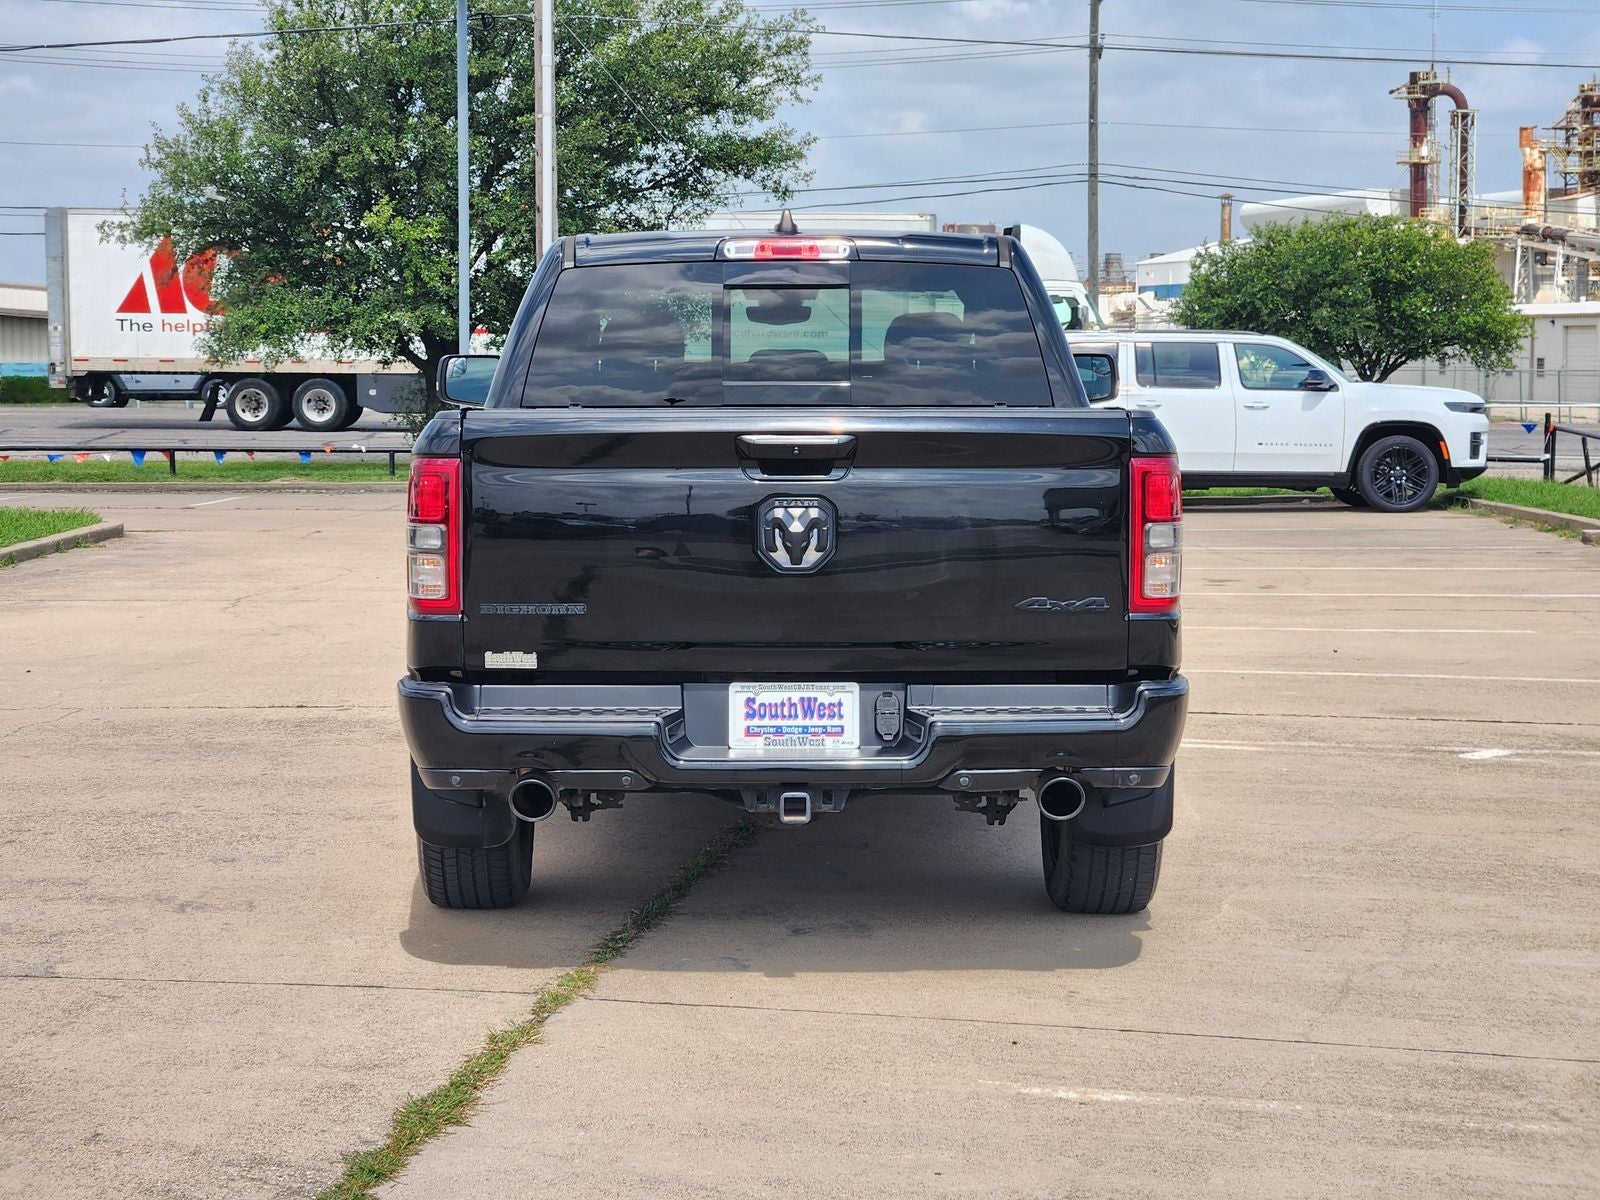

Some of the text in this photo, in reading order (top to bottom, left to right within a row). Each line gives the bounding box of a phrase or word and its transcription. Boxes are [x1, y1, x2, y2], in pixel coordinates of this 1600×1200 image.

[116, 318, 226, 336] The helpf
[480, 603, 587, 614] BIGHORN
[1014, 597, 1110, 611] 4x4
[744, 696, 844, 721] SouthWest
[749, 726, 841, 735] Chrysler Dodge Jeep Ram
[764, 737, 825, 747] SouthWest
